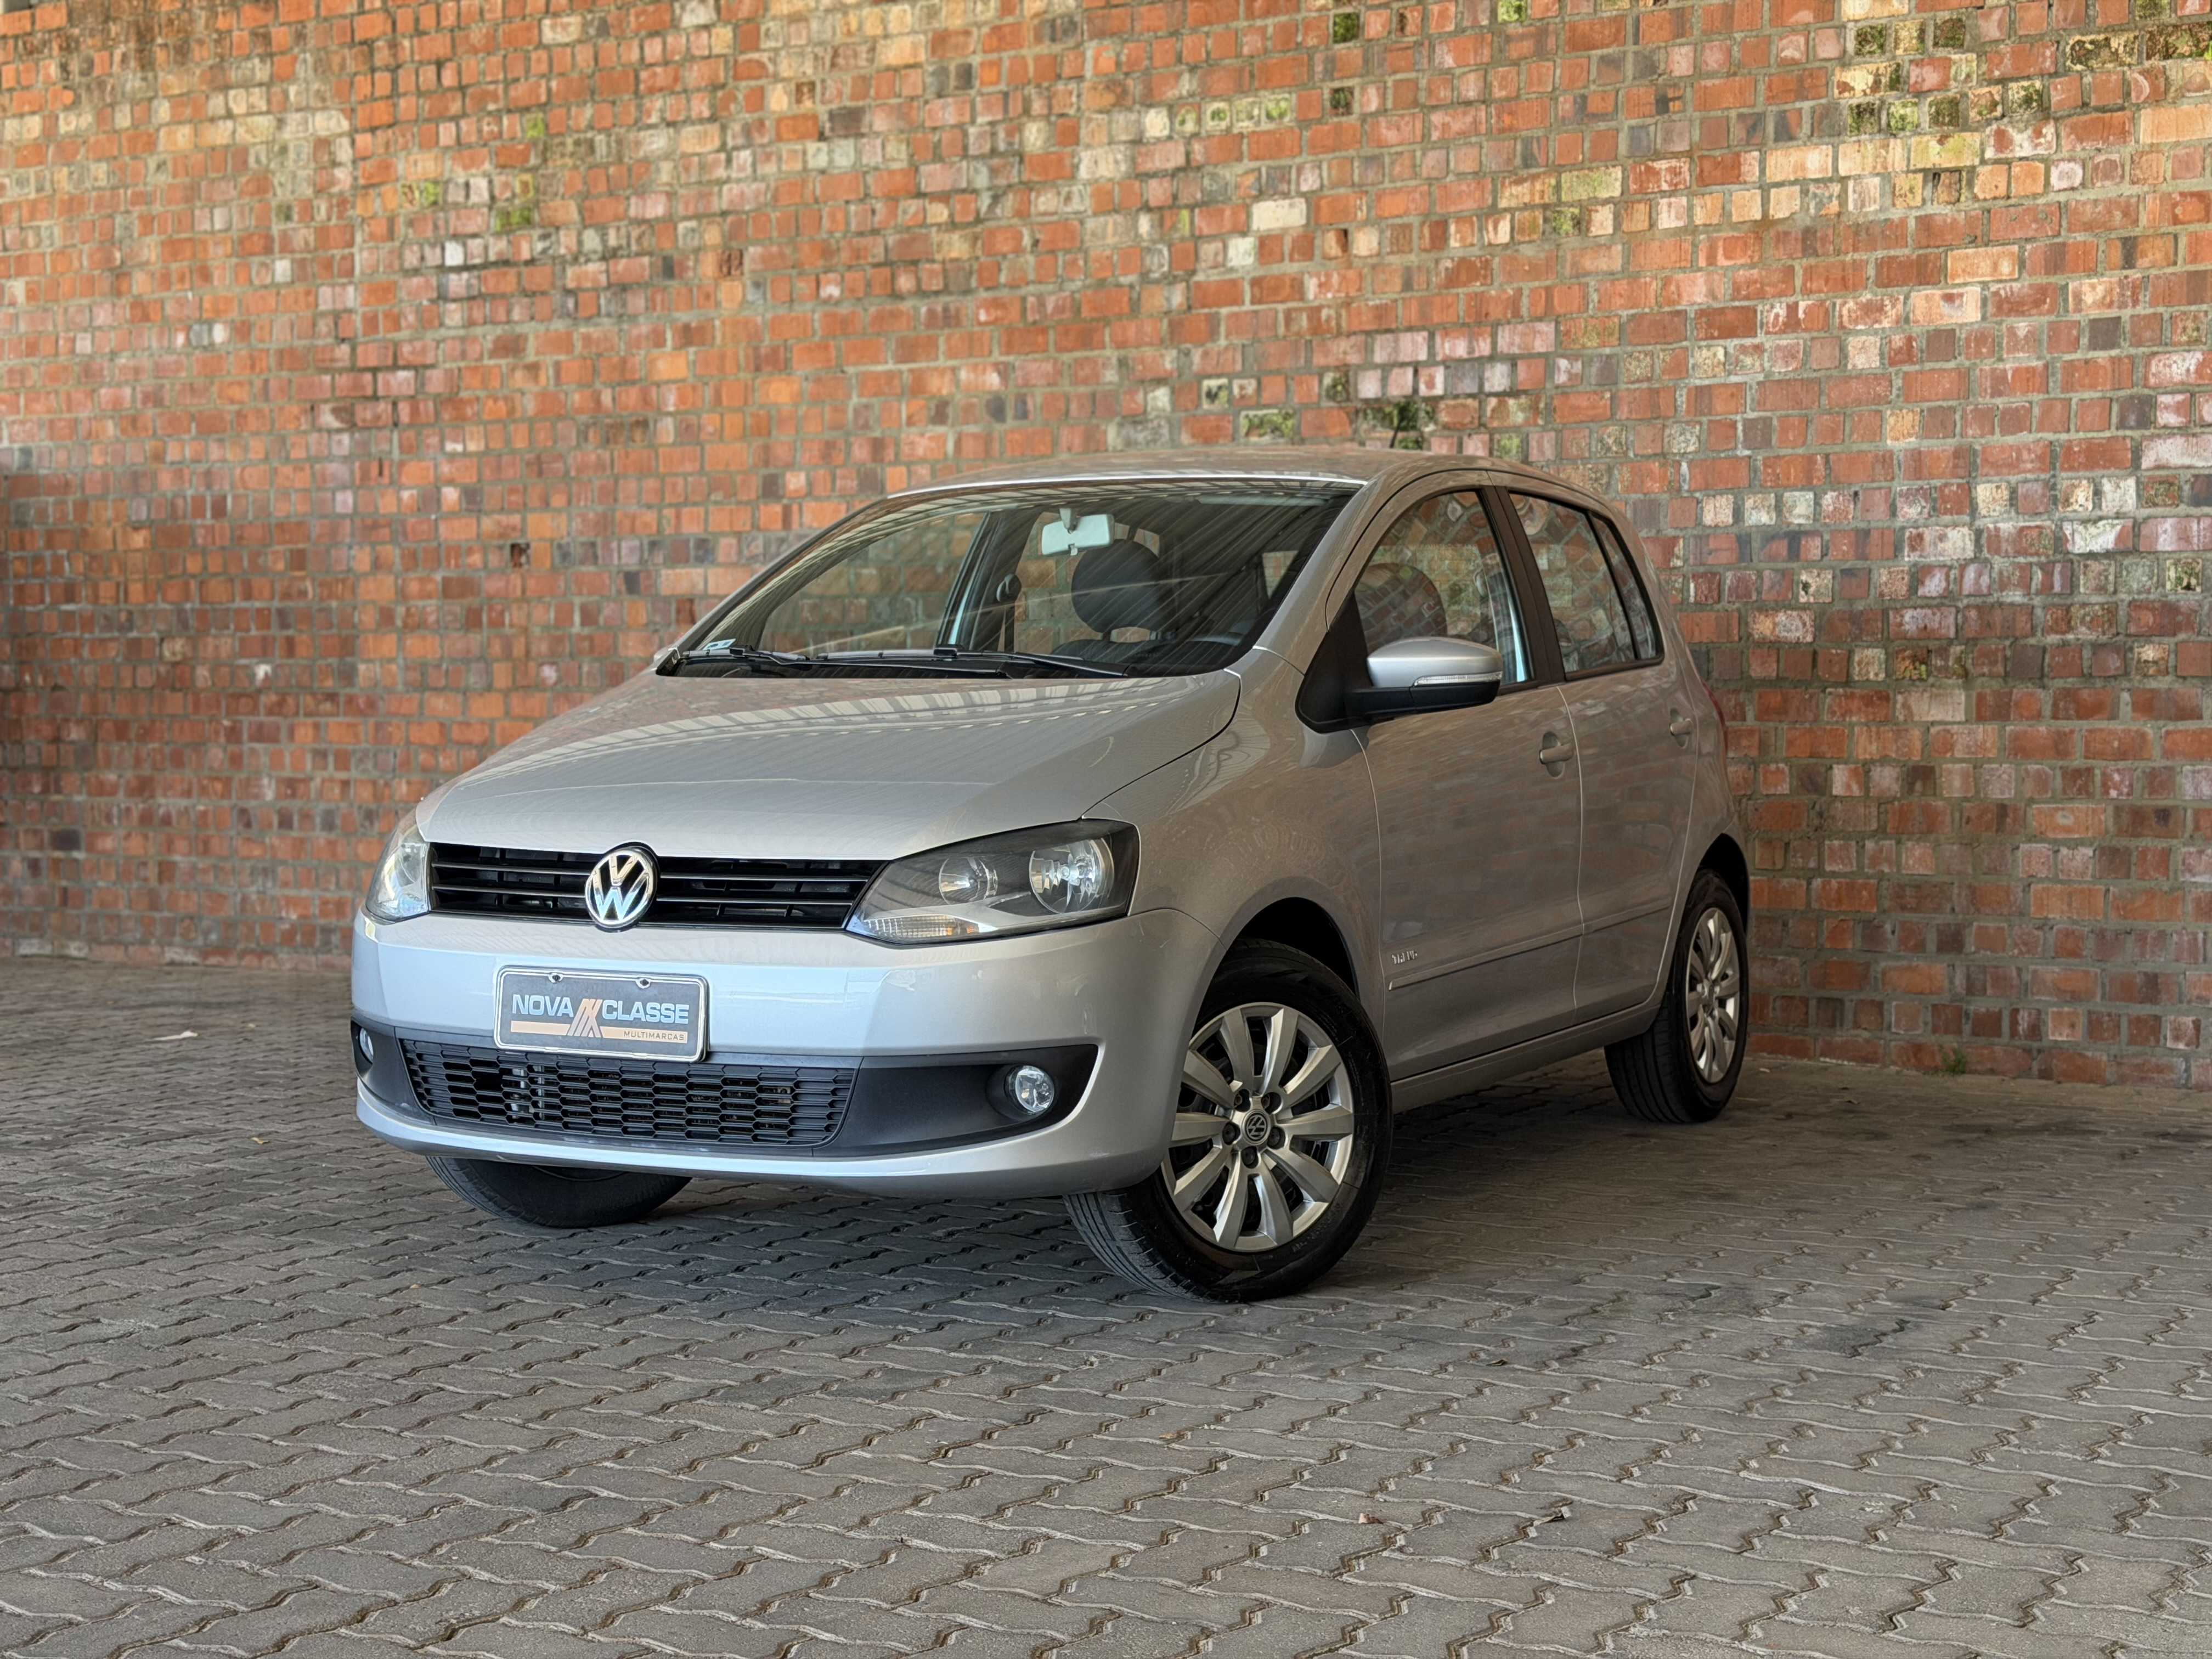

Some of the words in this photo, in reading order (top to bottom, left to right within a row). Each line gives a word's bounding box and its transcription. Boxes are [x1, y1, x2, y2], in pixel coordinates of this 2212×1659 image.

[589, 851, 652, 923] VW
[512, 994, 574, 1018] NOVA
[602, 1000, 690, 1024] CLASSE
[624, 1031, 685, 1041] MULTIMARCAS
